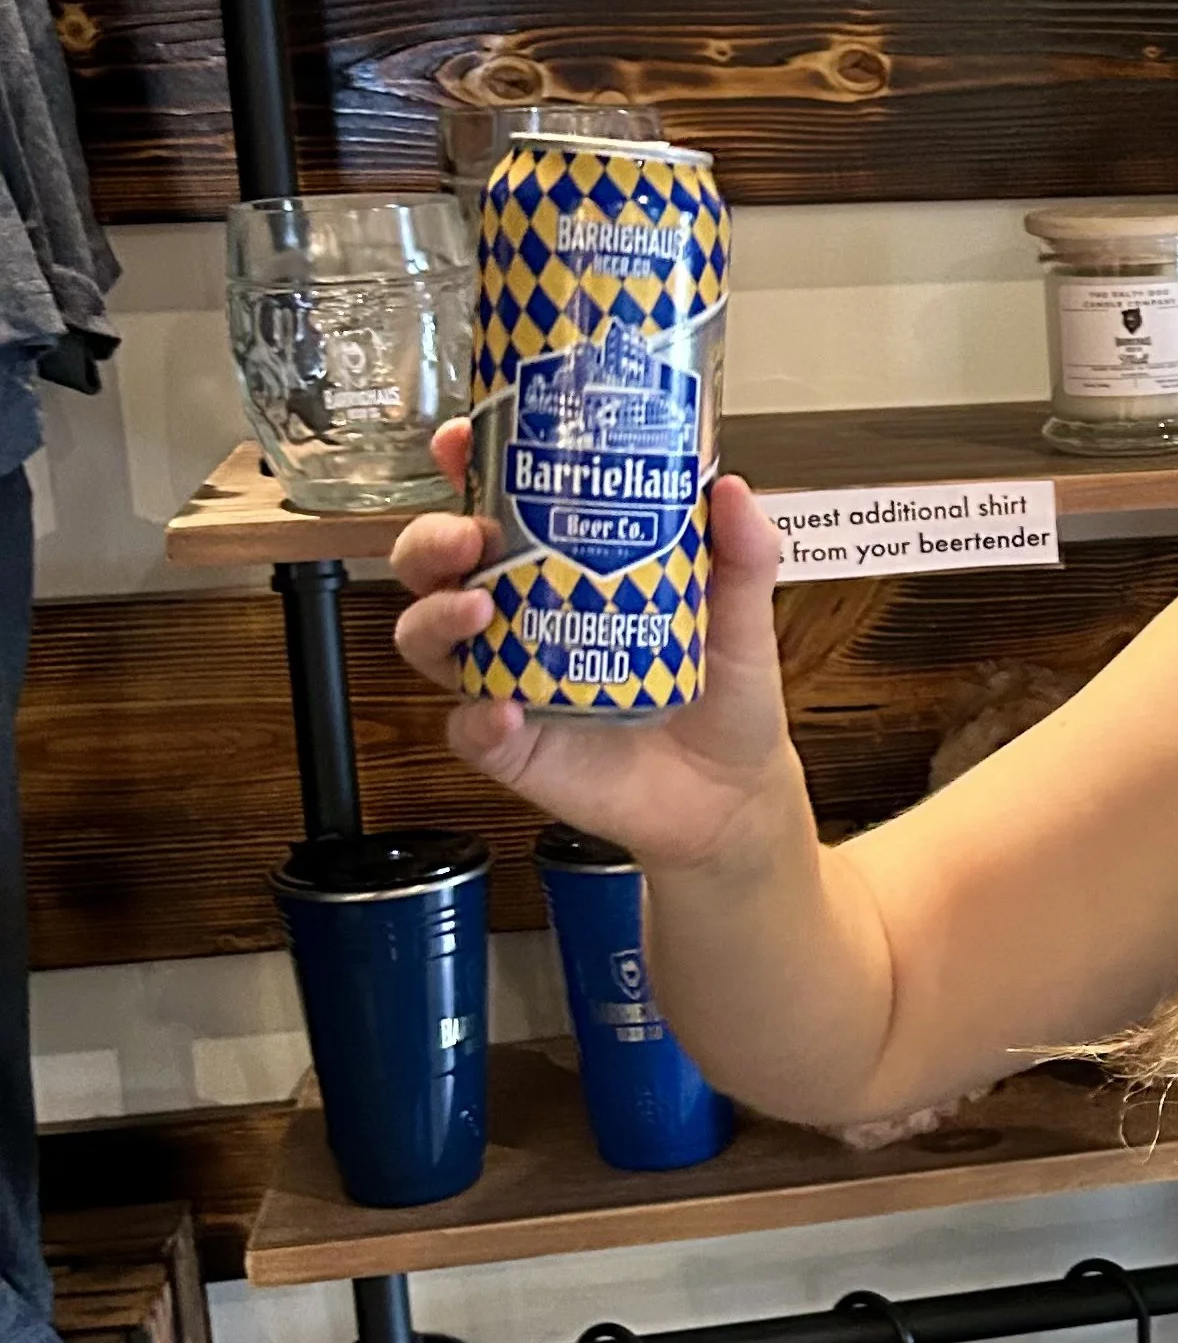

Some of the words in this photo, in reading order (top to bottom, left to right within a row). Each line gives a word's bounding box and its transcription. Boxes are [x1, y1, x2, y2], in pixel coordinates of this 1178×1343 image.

[515, 449, 693, 500] BarrieHaus
[567, 513, 615, 538] Beer
[850, 496, 969, 525] additional
[979, 494, 1027, 517] shirt
[793, 541, 847, 563] from
[856, 540, 910, 565] your
[920, 526, 1050, 554] beertender
[522, 608, 673, 648] OKTOBERFEST
[568, 650, 630, 684] GOLD
